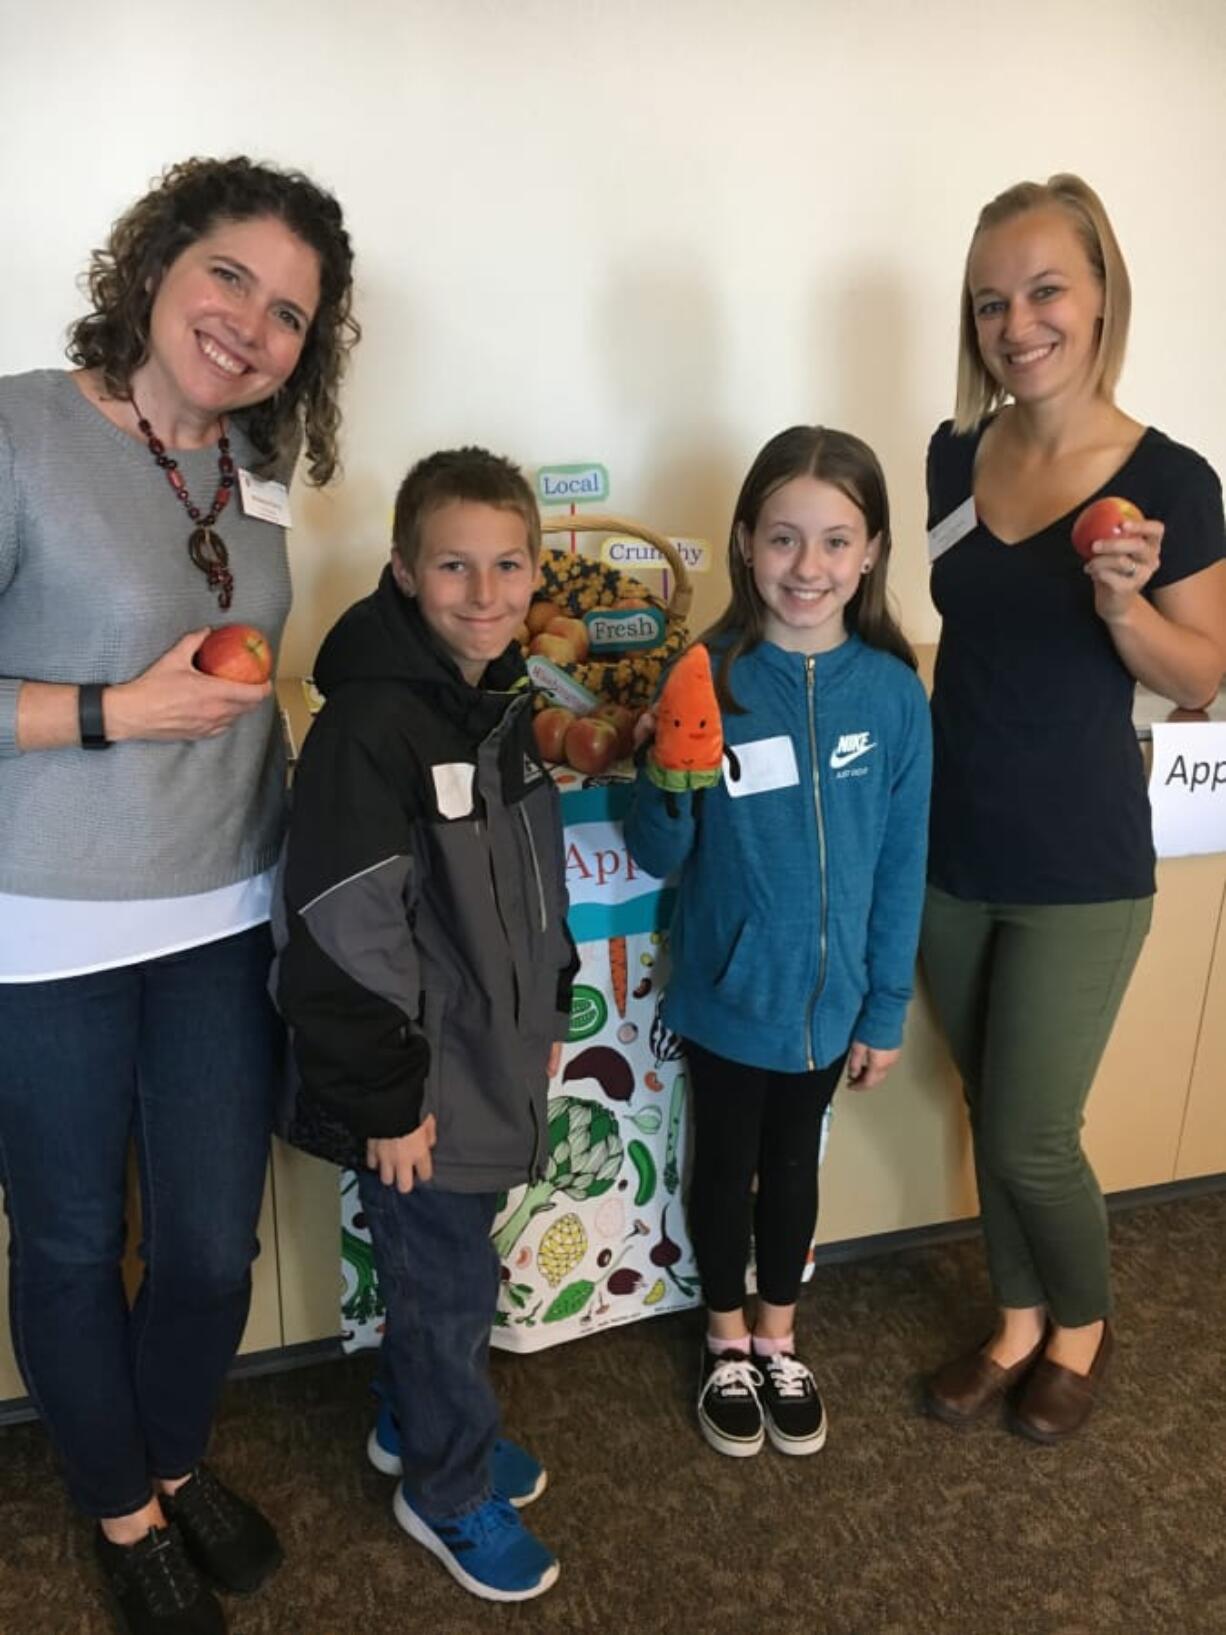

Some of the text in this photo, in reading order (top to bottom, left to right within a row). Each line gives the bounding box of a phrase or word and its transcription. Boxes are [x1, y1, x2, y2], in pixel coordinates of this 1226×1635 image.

[544, 473, 598, 494] Local
[609, 542, 703, 565] Crunhy
[595, 618, 654, 640] Fresh
[837, 731, 870, 753] NIKE
[1165, 755, 1226, 792] App
